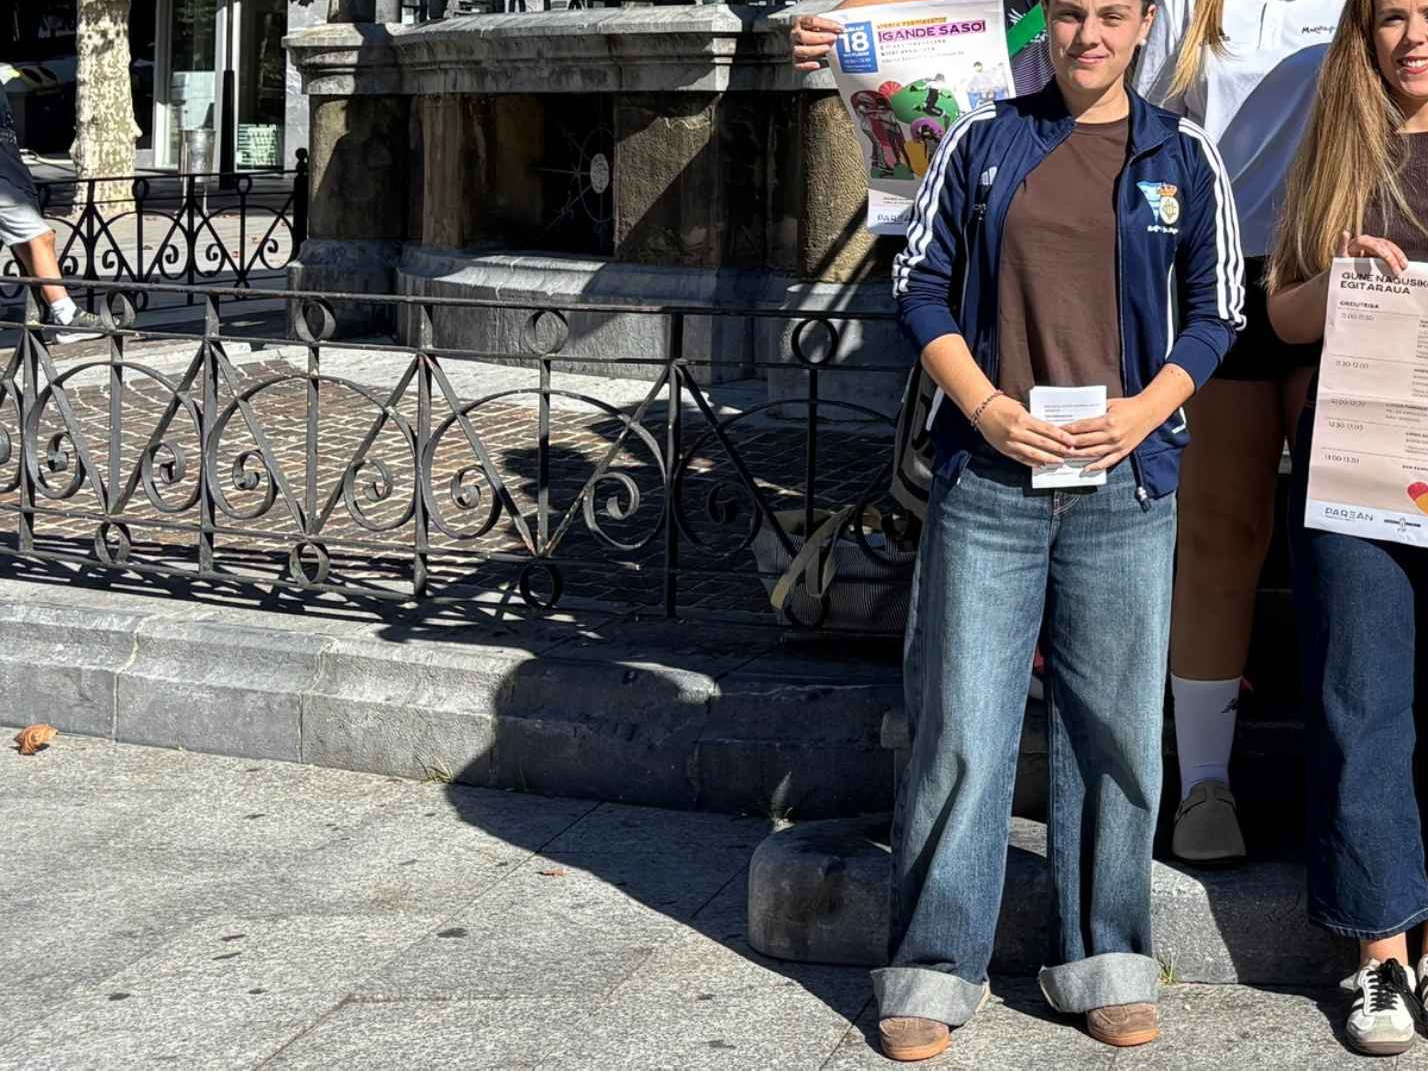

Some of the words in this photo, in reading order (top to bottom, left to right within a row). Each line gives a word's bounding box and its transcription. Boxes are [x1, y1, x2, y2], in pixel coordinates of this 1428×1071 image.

[877, 27, 936, 43] IGANDE
[939, 20, 986, 36] SASOI
[837, 30, 870, 53] 18
[1341, 271, 1374, 283] GUNE
[1340, 281, 1411, 295] EGITARAUA
[1324, 506, 1374, 522] PAREAN
